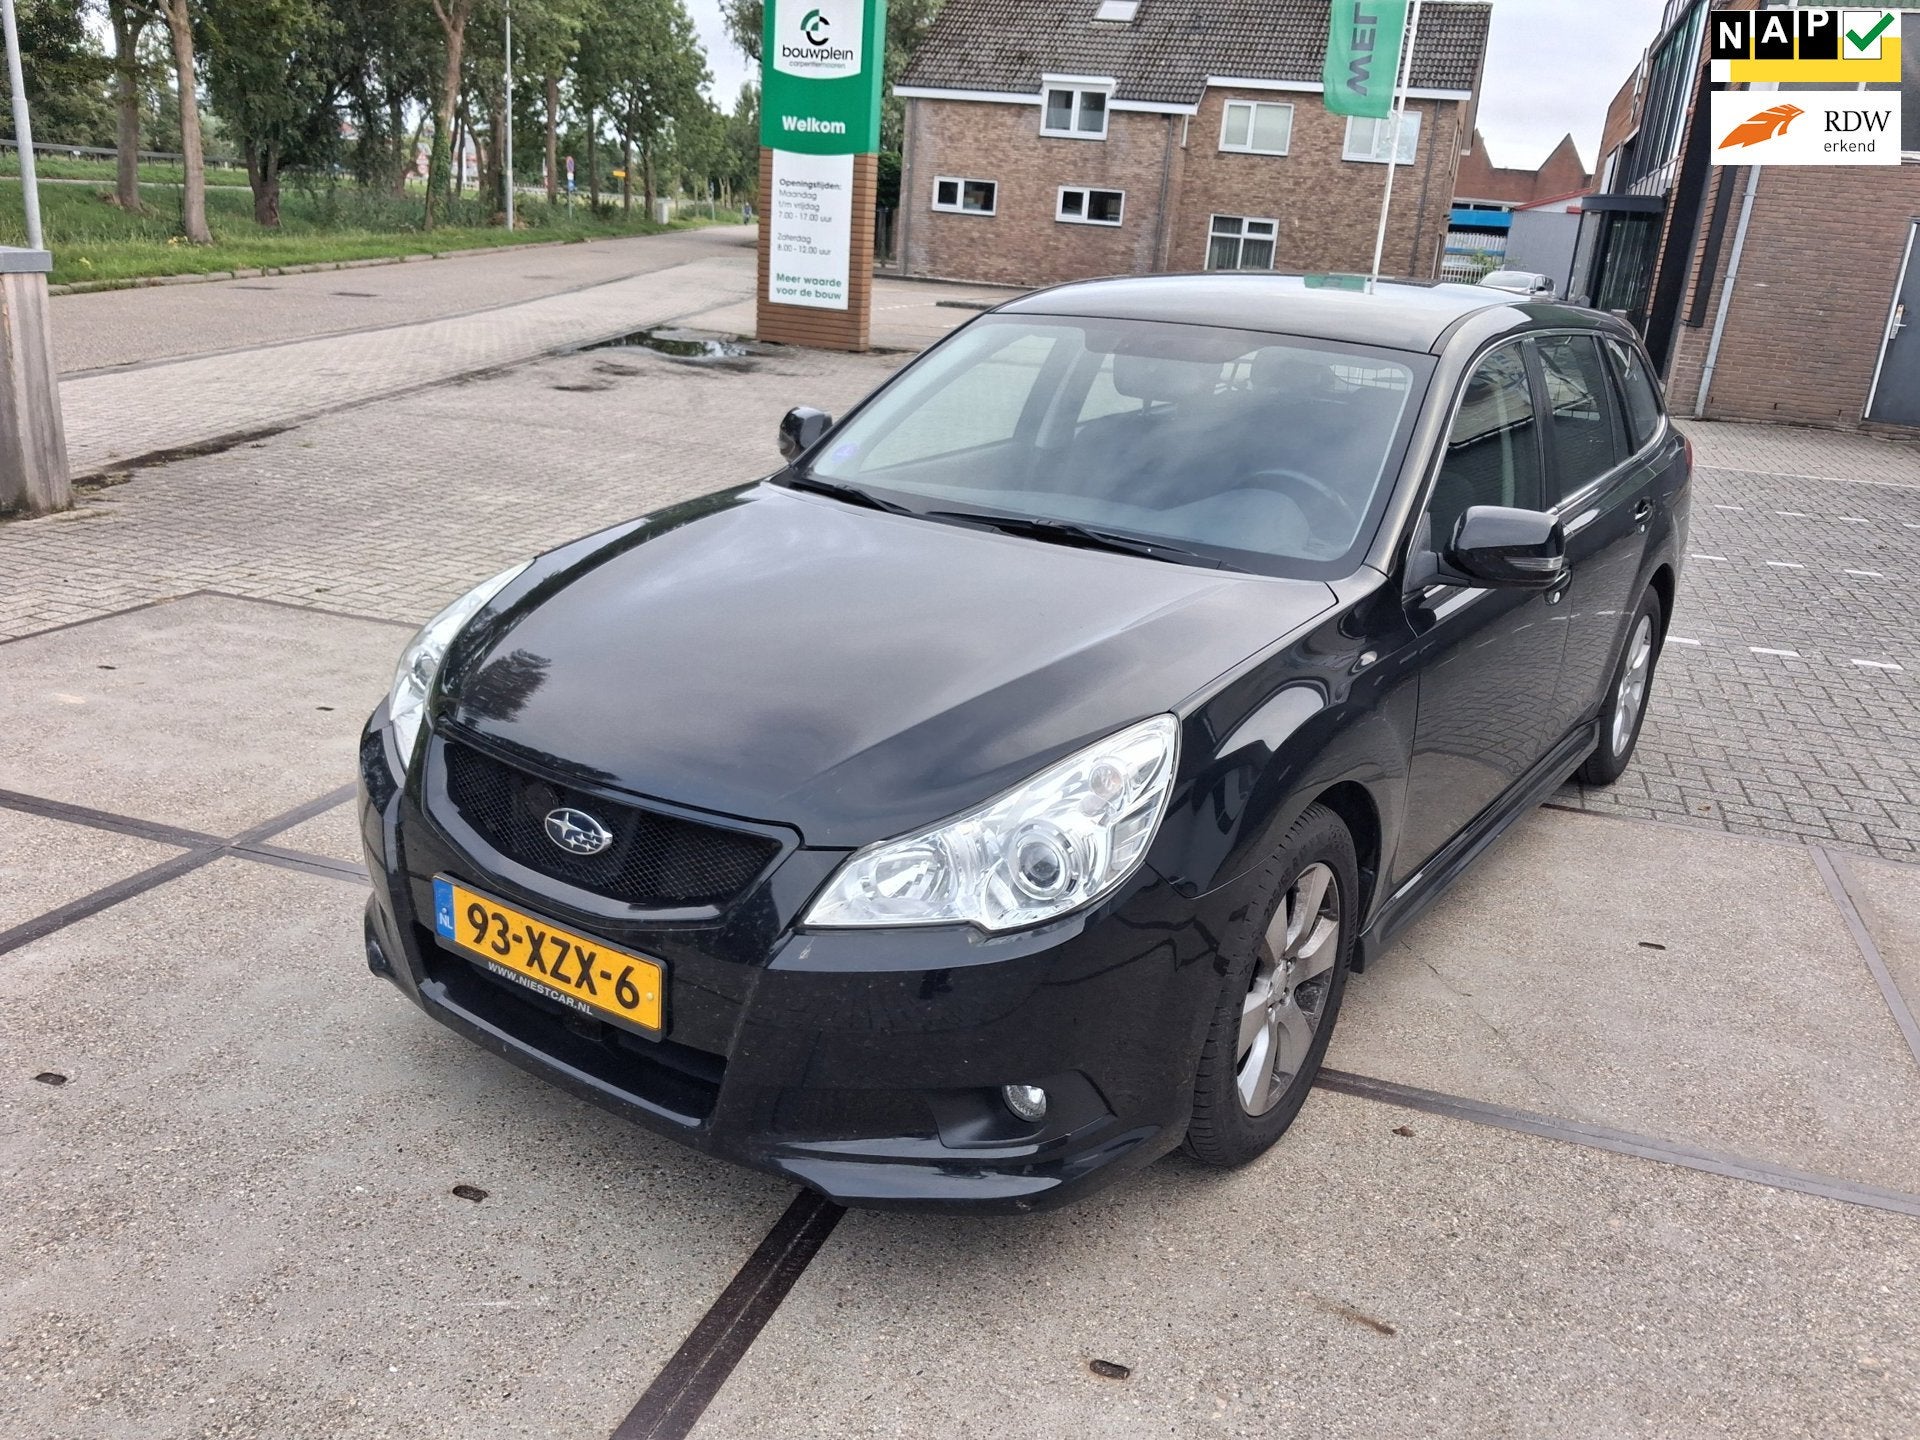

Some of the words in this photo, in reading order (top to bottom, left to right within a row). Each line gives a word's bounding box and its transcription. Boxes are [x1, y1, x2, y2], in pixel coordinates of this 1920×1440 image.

[782, 44, 853, 61] bouwplein
[781, 115, 846, 134] Welkom
[779, 189, 818, 201] Maandag
[794, 202, 820, 212] vrijdag
[777, 232, 812, 244] Zaterdag
[776, 272, 801, 284] Meer
[803, 277, 842, 288] waarde
[776, 287, 798, 296] voor
[799, 288, 812, 298] de
[814, 289, 842, 300] bouw
[438, 911, 454, 930] NL
[467, 902, 640, 1010] 93-XZX-6
[488, 961, 593, 1015] WWW.NIESTCAR.NL
